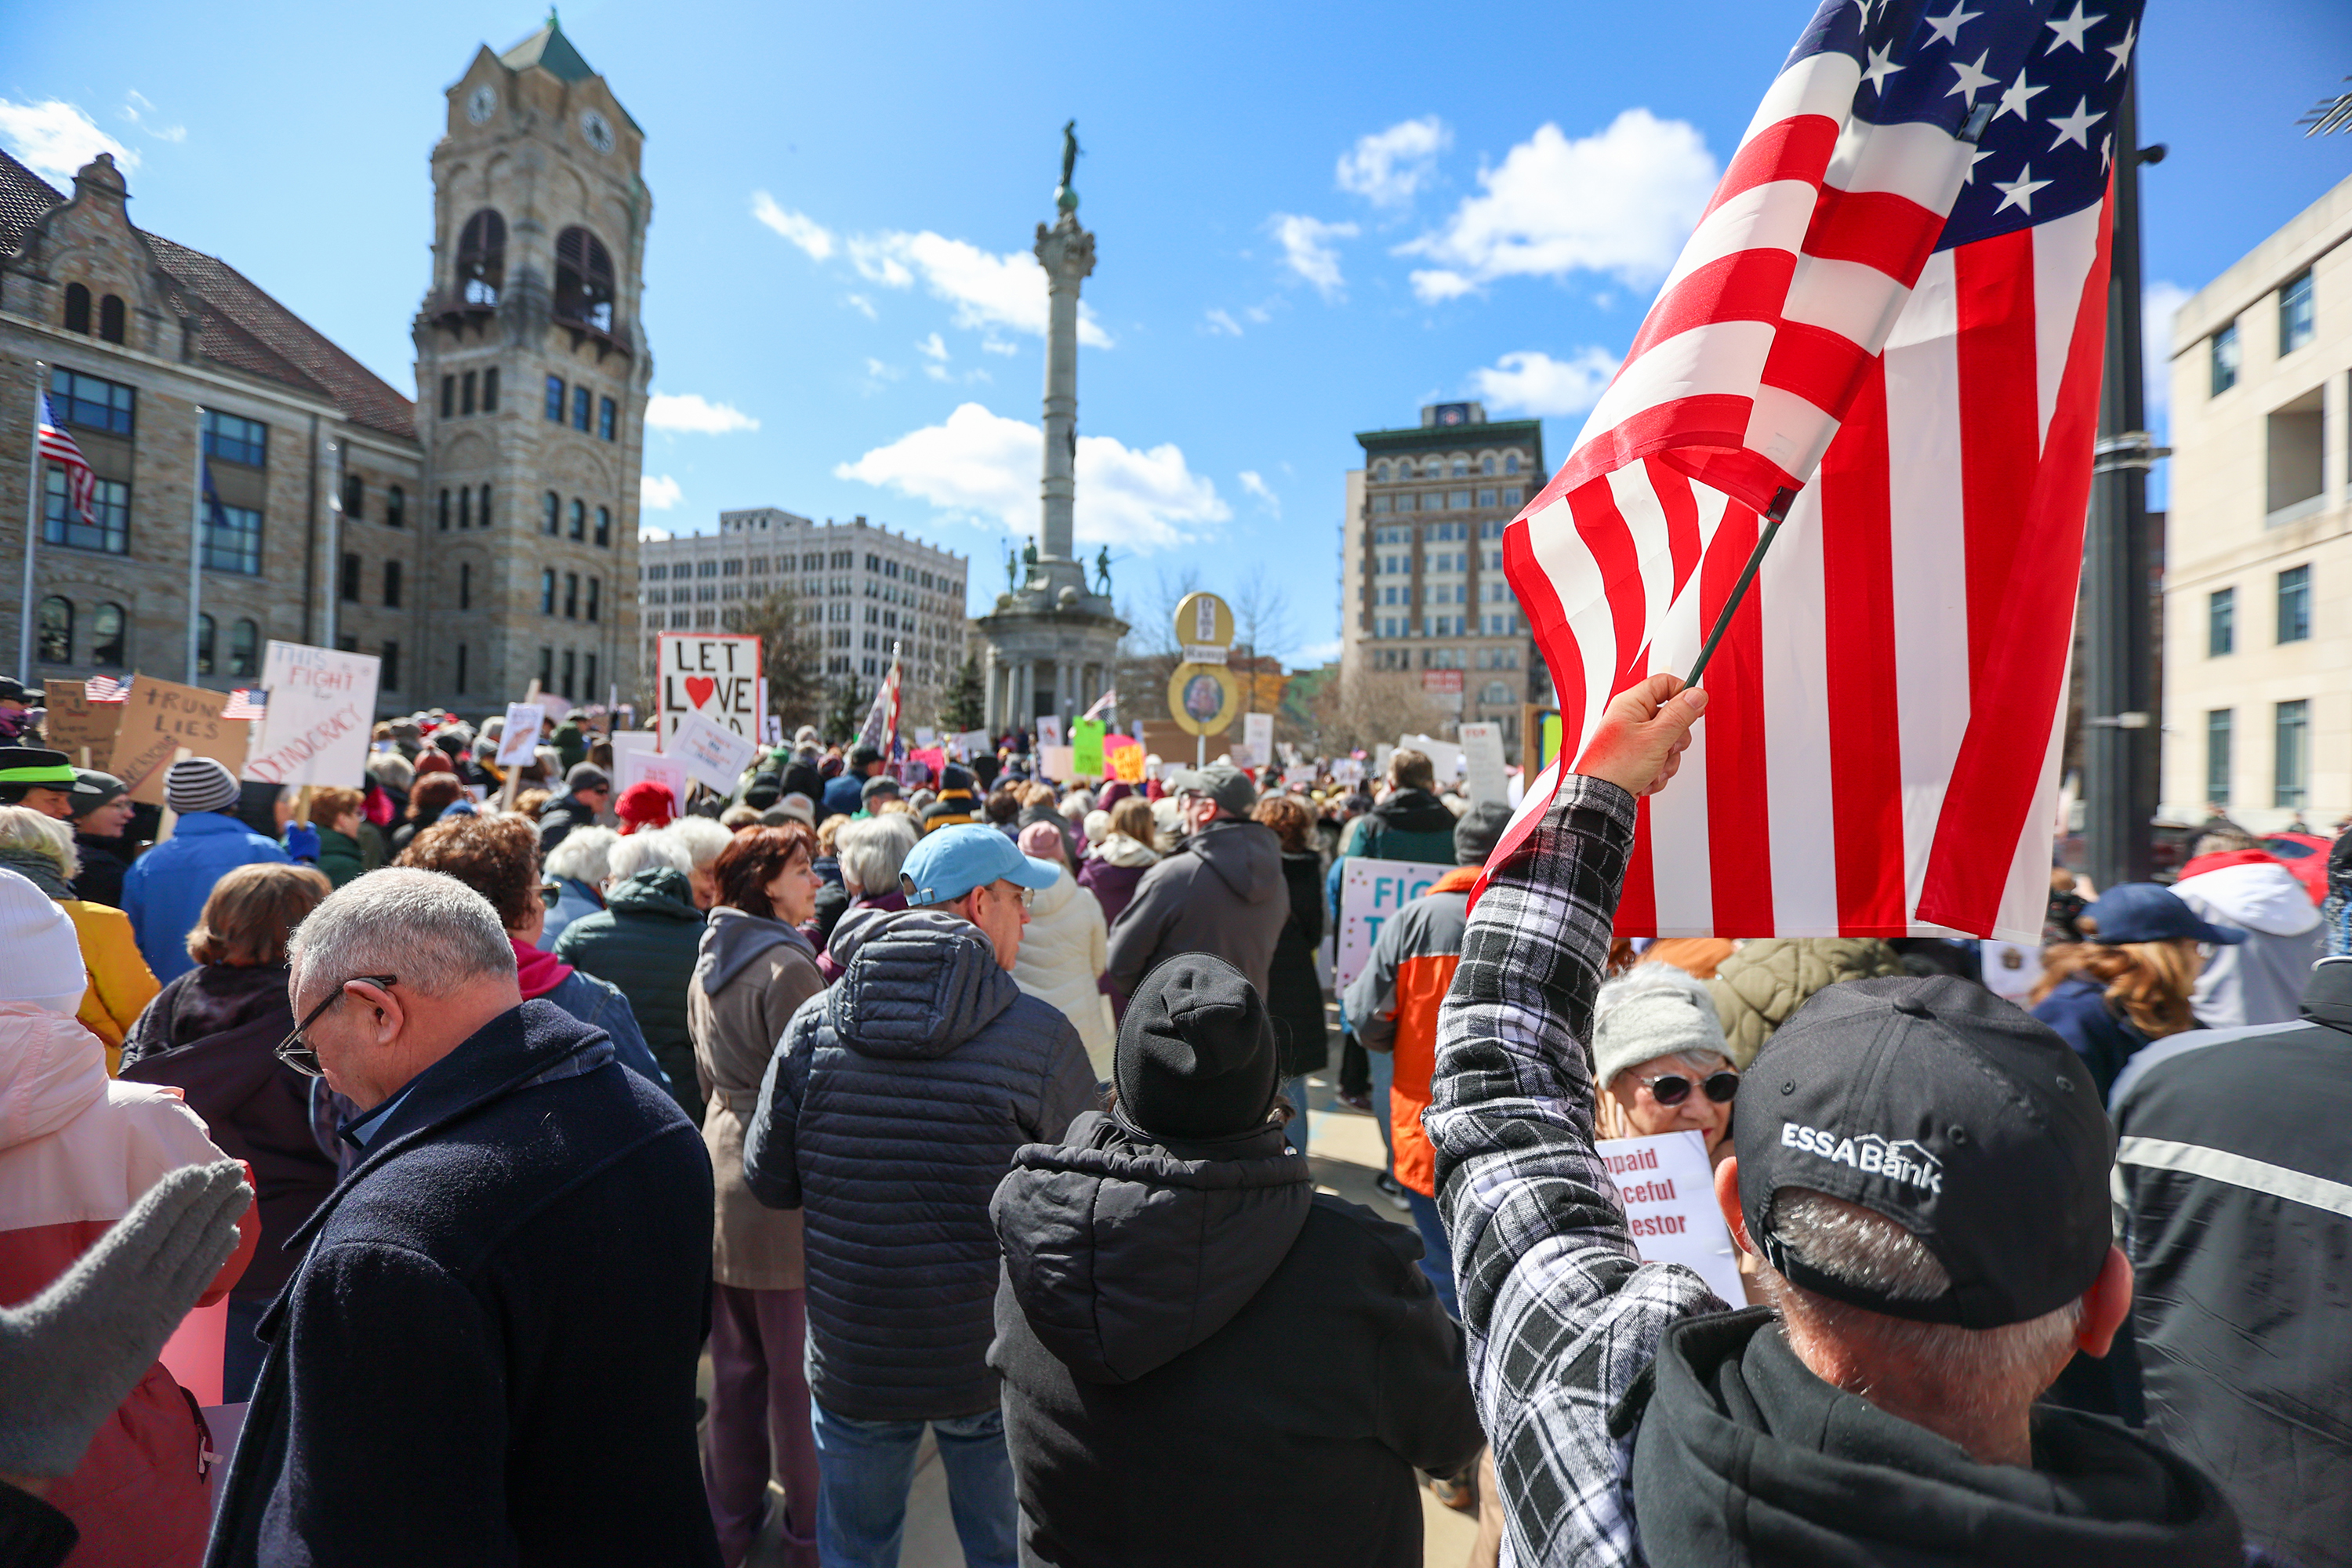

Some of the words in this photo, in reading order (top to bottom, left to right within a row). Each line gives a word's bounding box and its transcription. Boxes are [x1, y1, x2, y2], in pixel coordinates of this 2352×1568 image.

[275, 644, 327, 671] THIS
[676, 641, 739, 673] LET
[289, 665, 354, 691] FIGHT
[155, 713, 220, 740] LIES
[249, 703, 364, 784] DEMOCRACY
[1621, 1178, 1676, 1203] ceful
[1630, 1215, 1686, 1236] estor
